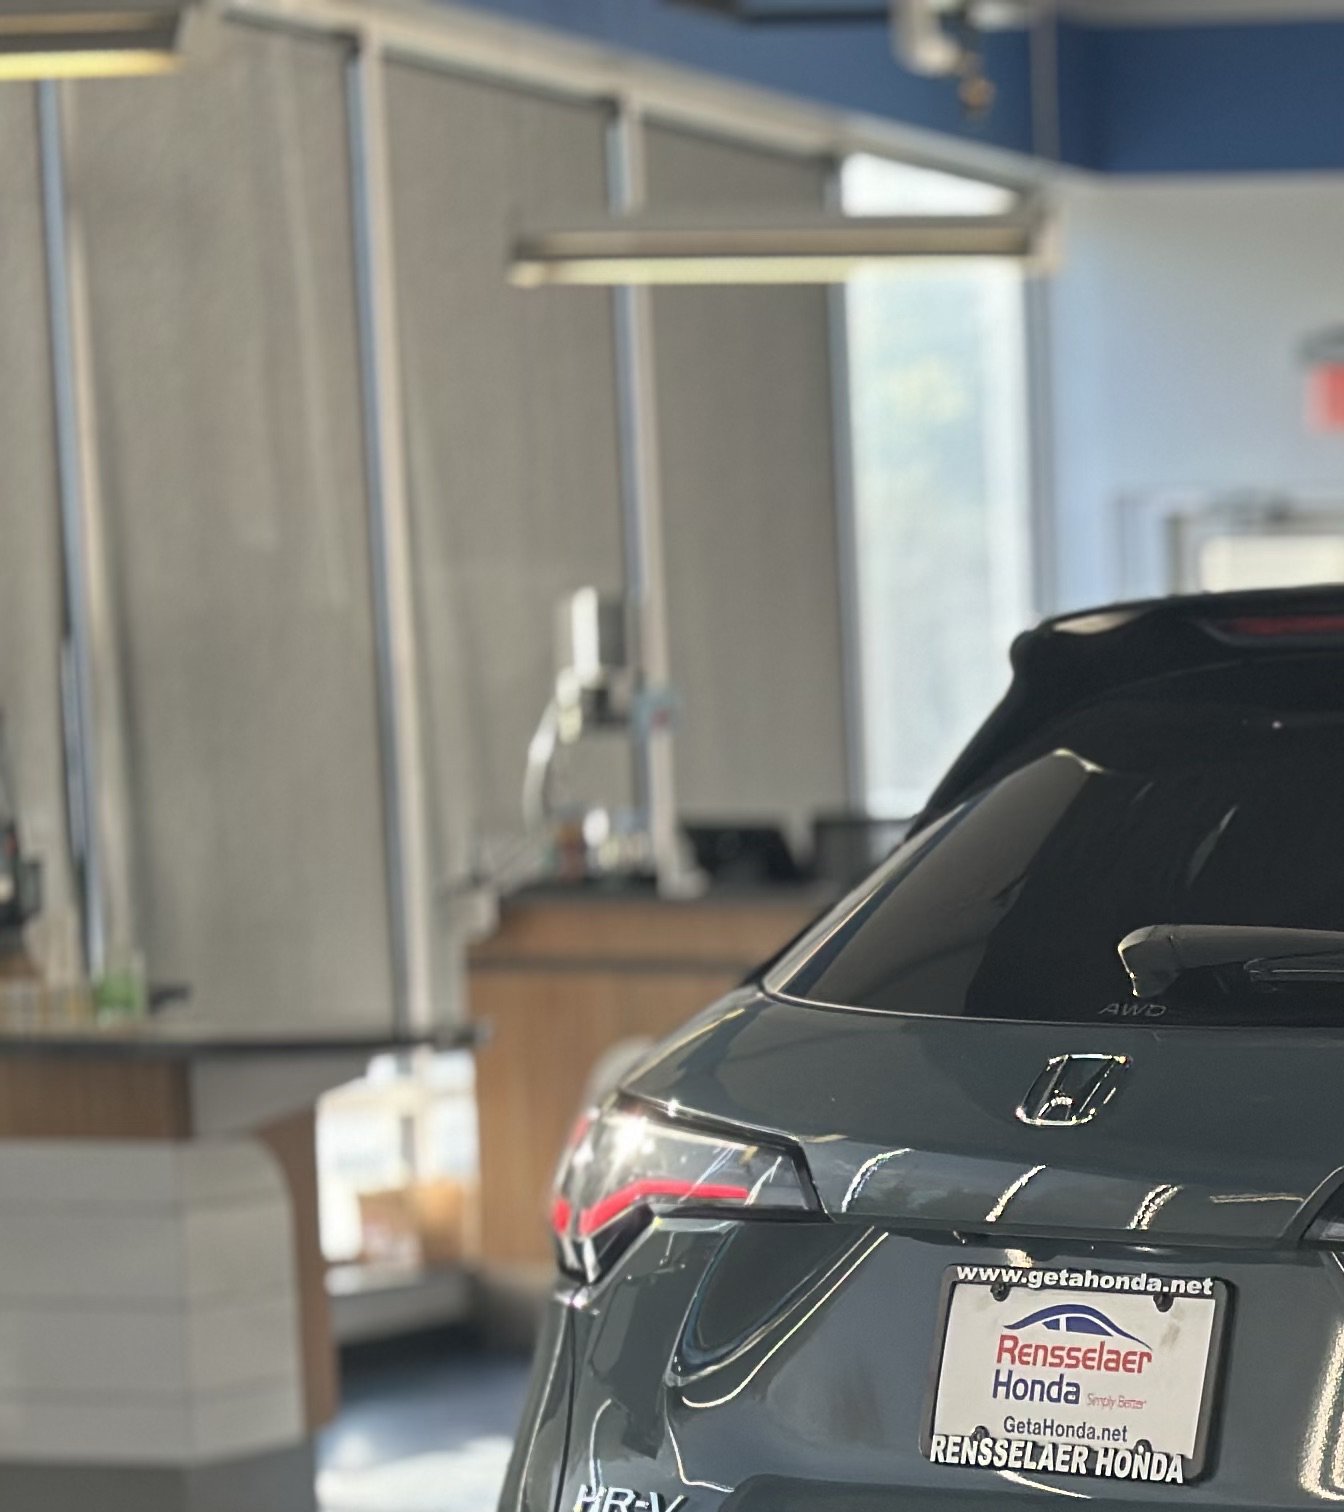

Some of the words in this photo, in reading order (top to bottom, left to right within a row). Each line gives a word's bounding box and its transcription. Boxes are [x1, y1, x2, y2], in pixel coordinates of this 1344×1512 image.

[1098, 1003, 1167, 1017] AWD
[956, 1266, 1213, 1295] www.getahonda.net
[996, 1333, 1153, 1374] Rensselaer
[992, 1369, 1081, 1405] Honda
[1003, 1415, 1128, 1443] GetaHonda.net
[929, 1434, 1089, 1475] RENSSELAER
[1095, 1446, 1184, 1484] HONDA
